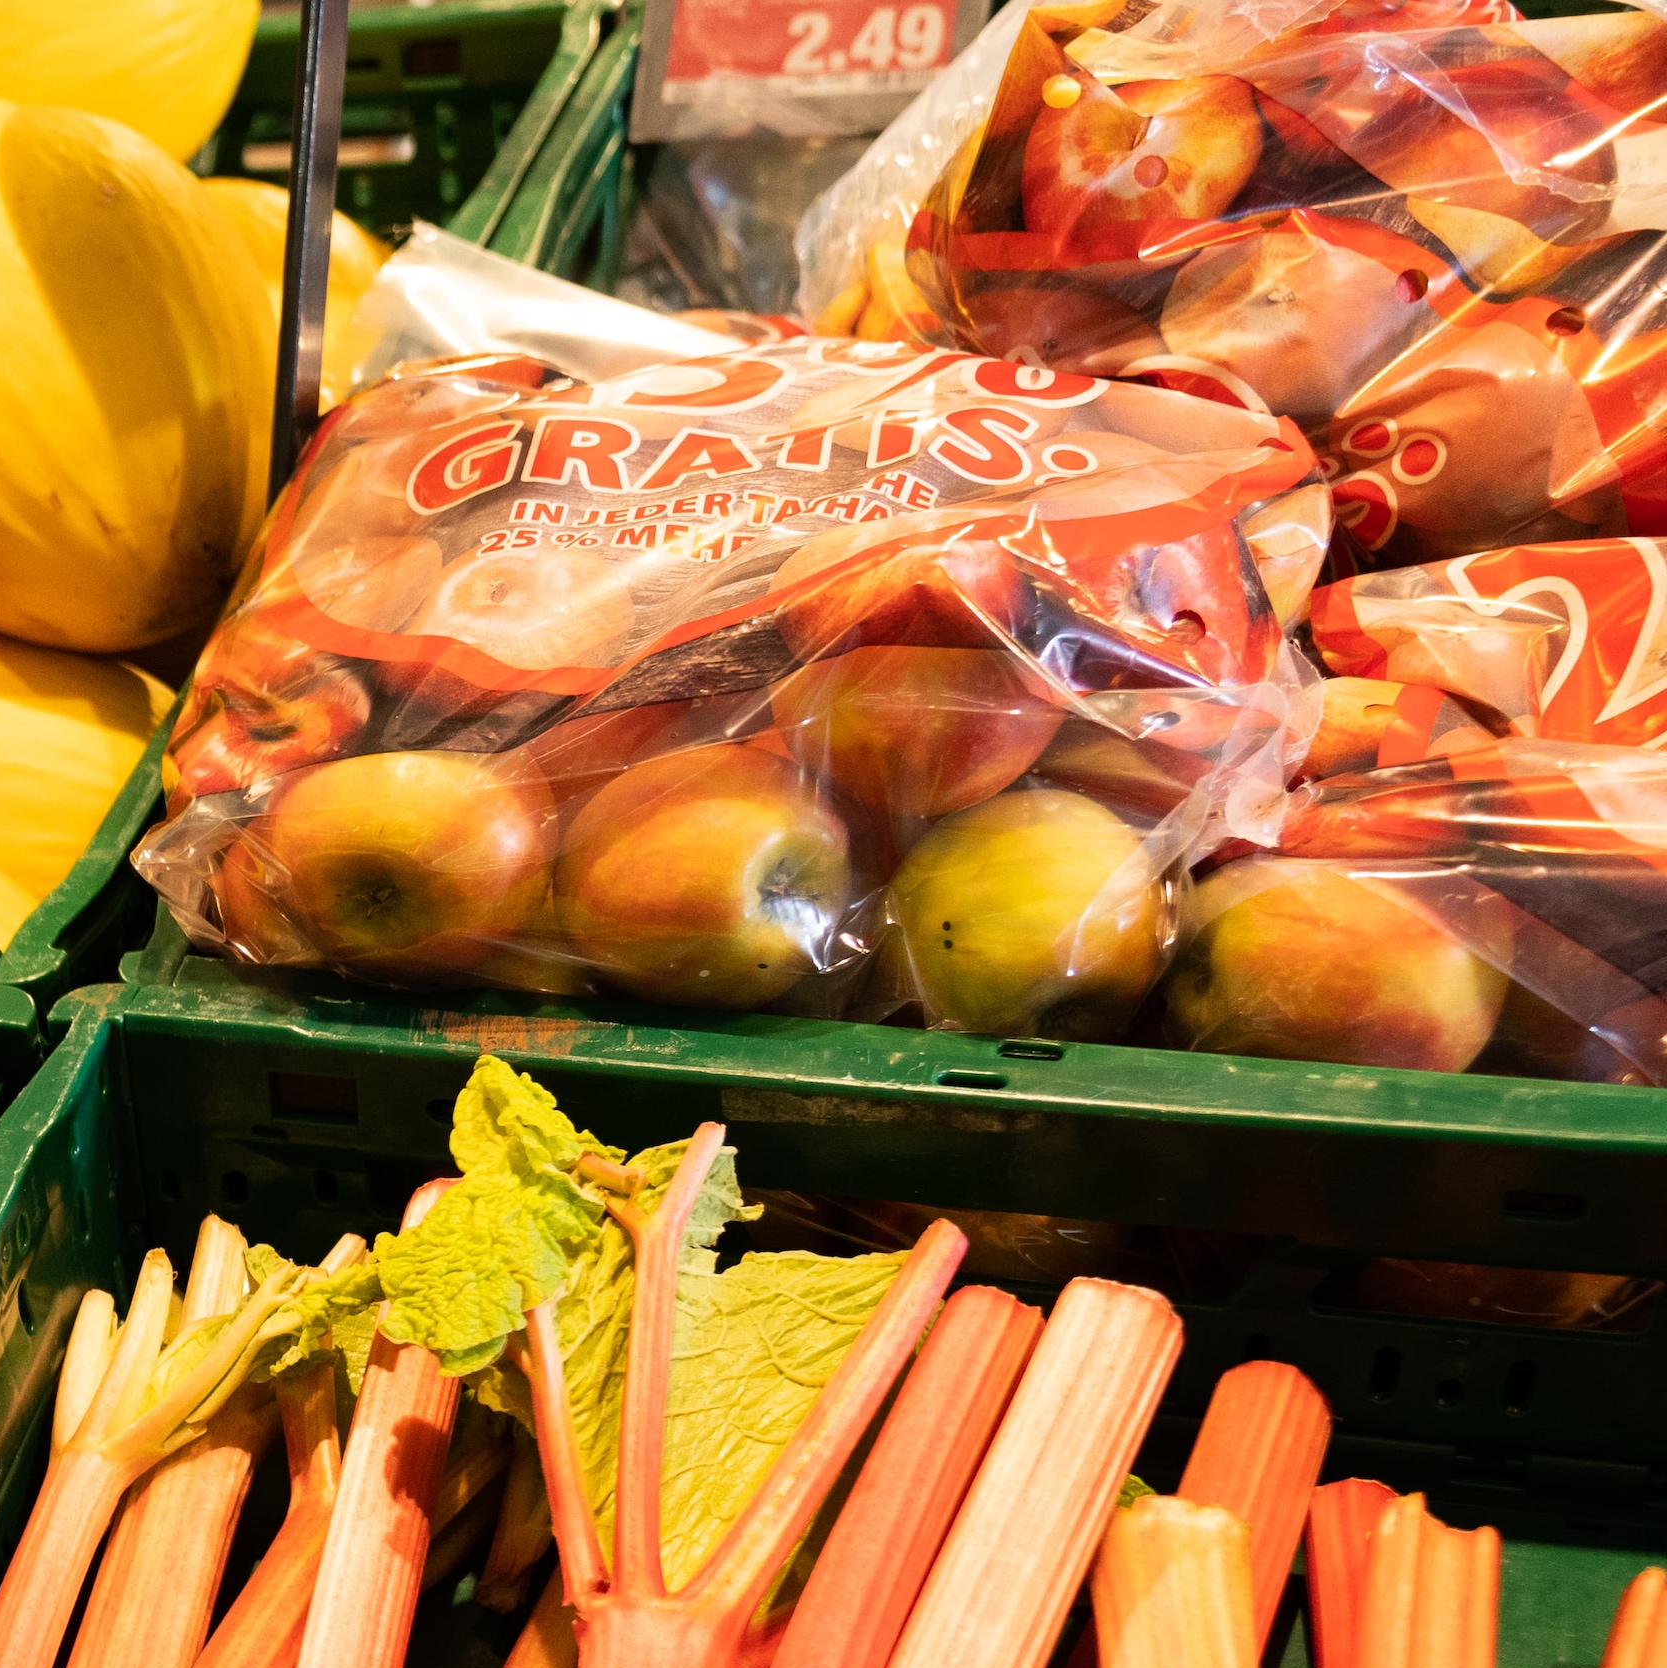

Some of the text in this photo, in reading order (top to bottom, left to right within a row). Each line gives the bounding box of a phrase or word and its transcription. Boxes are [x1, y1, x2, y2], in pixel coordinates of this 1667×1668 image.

[781, 4, 946, 73] 2.49
[510, 499, 567, 527] IN
[572, 490, 737, 528] JEDER
[476, 526, 541, 558] 25
[550, 530, 603, 550] %
